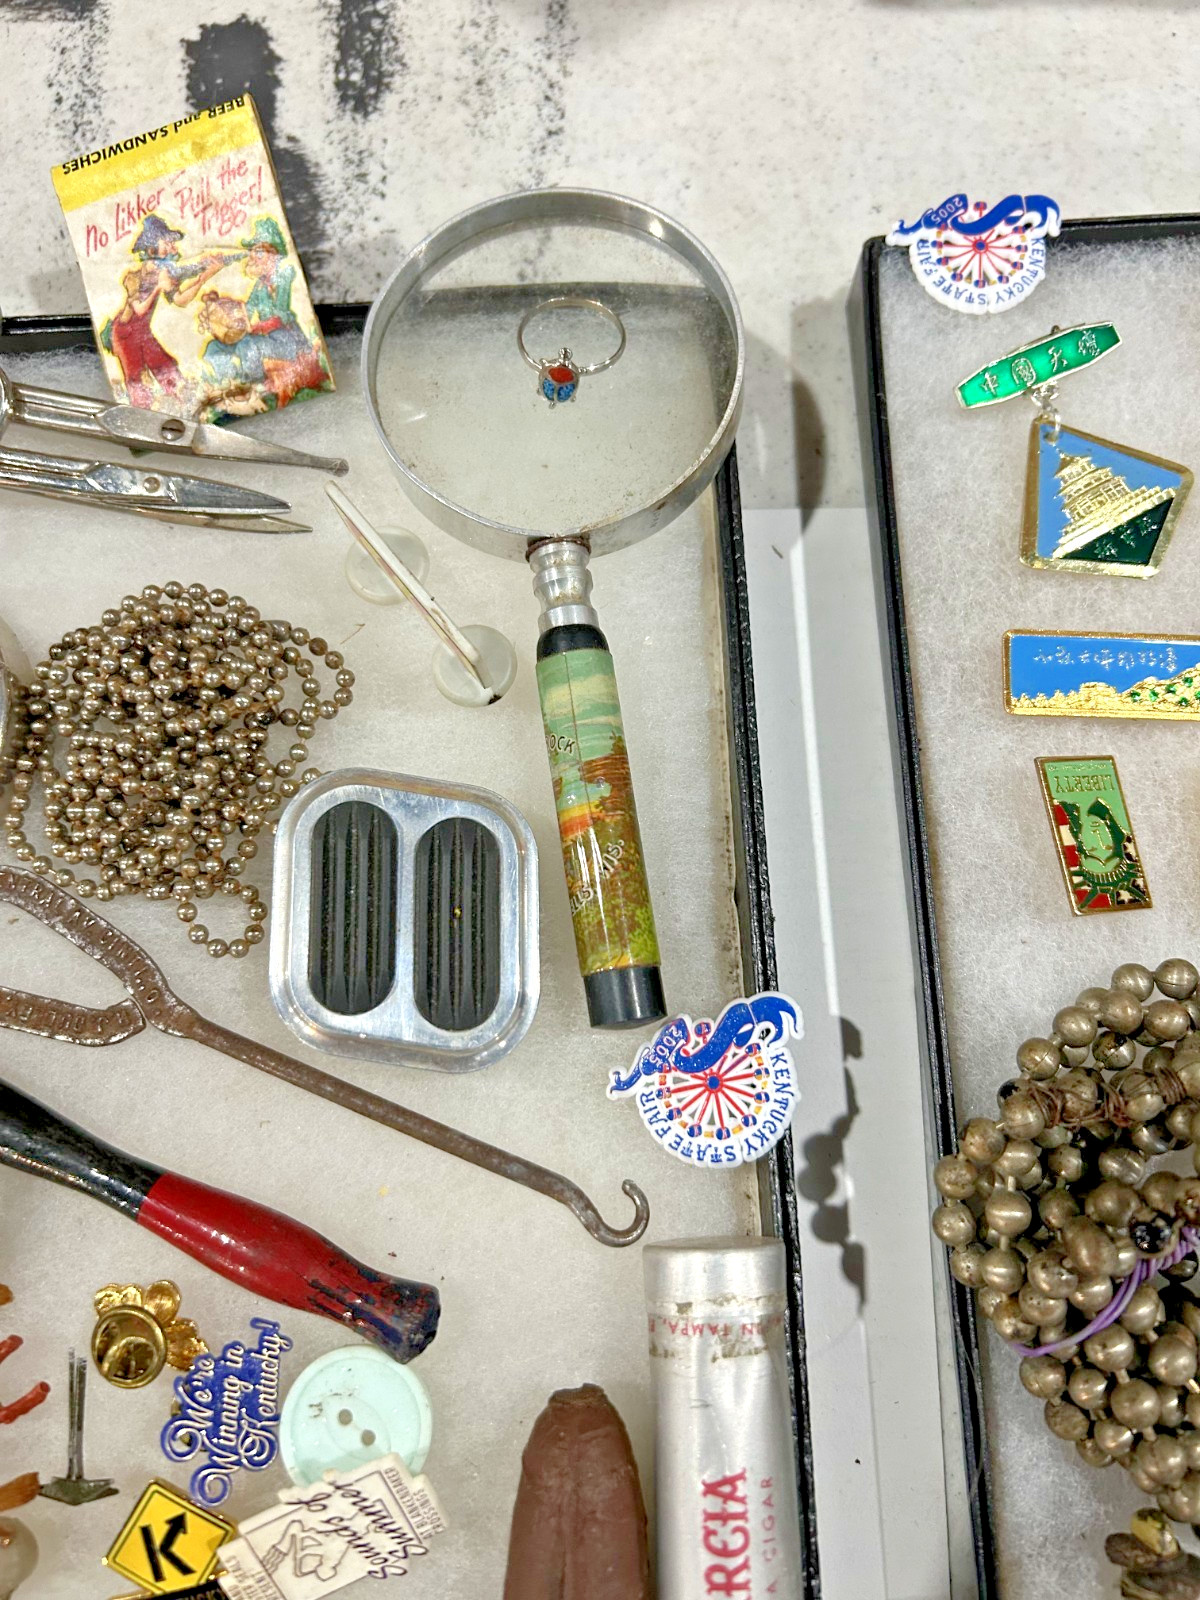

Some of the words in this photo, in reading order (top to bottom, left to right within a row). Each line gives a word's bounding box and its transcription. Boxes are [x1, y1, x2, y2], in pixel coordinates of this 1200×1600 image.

[62, 126, 169, 175] SANDWICHES
[173, 113, 204, 134] and
[113, 188, 165, 243] Likker
[174, 179, 212, 219] Pull
[216, 158, 249, 191] the
[193, 165, 264, 237] Trigger!
[930, 196, 963, 226] 2005
[916, 239, 939, 278] FAIR
[994, 238, 1047, 305] KENTUCKY
[932, 274, 987, 306] STATE
[1053, 774, 1115, 793] LIBERTY
[648, 1025, 684, 1068] 2005
[639, 1089, 673, 1141] FAIR
[745, 1052, 796, 1156] KENTUCKY
[668, 1132, 737, 1164] STATE
[165, 1357, 216, 1462] We're
[237, 1318, 290, 1468] Kentucky!
[191, 1374, 254, 1506] Winning
[223, 1345, 245, 1371] in
[284, 1490, 330, 1516] of
[330, 1478, 429, 1560] Summer
[760, 1475, 777, 1563] CIGAR
[320, 1516, 408, 1580] Sounds
[700, 1467, 752, 1600] RCIA
